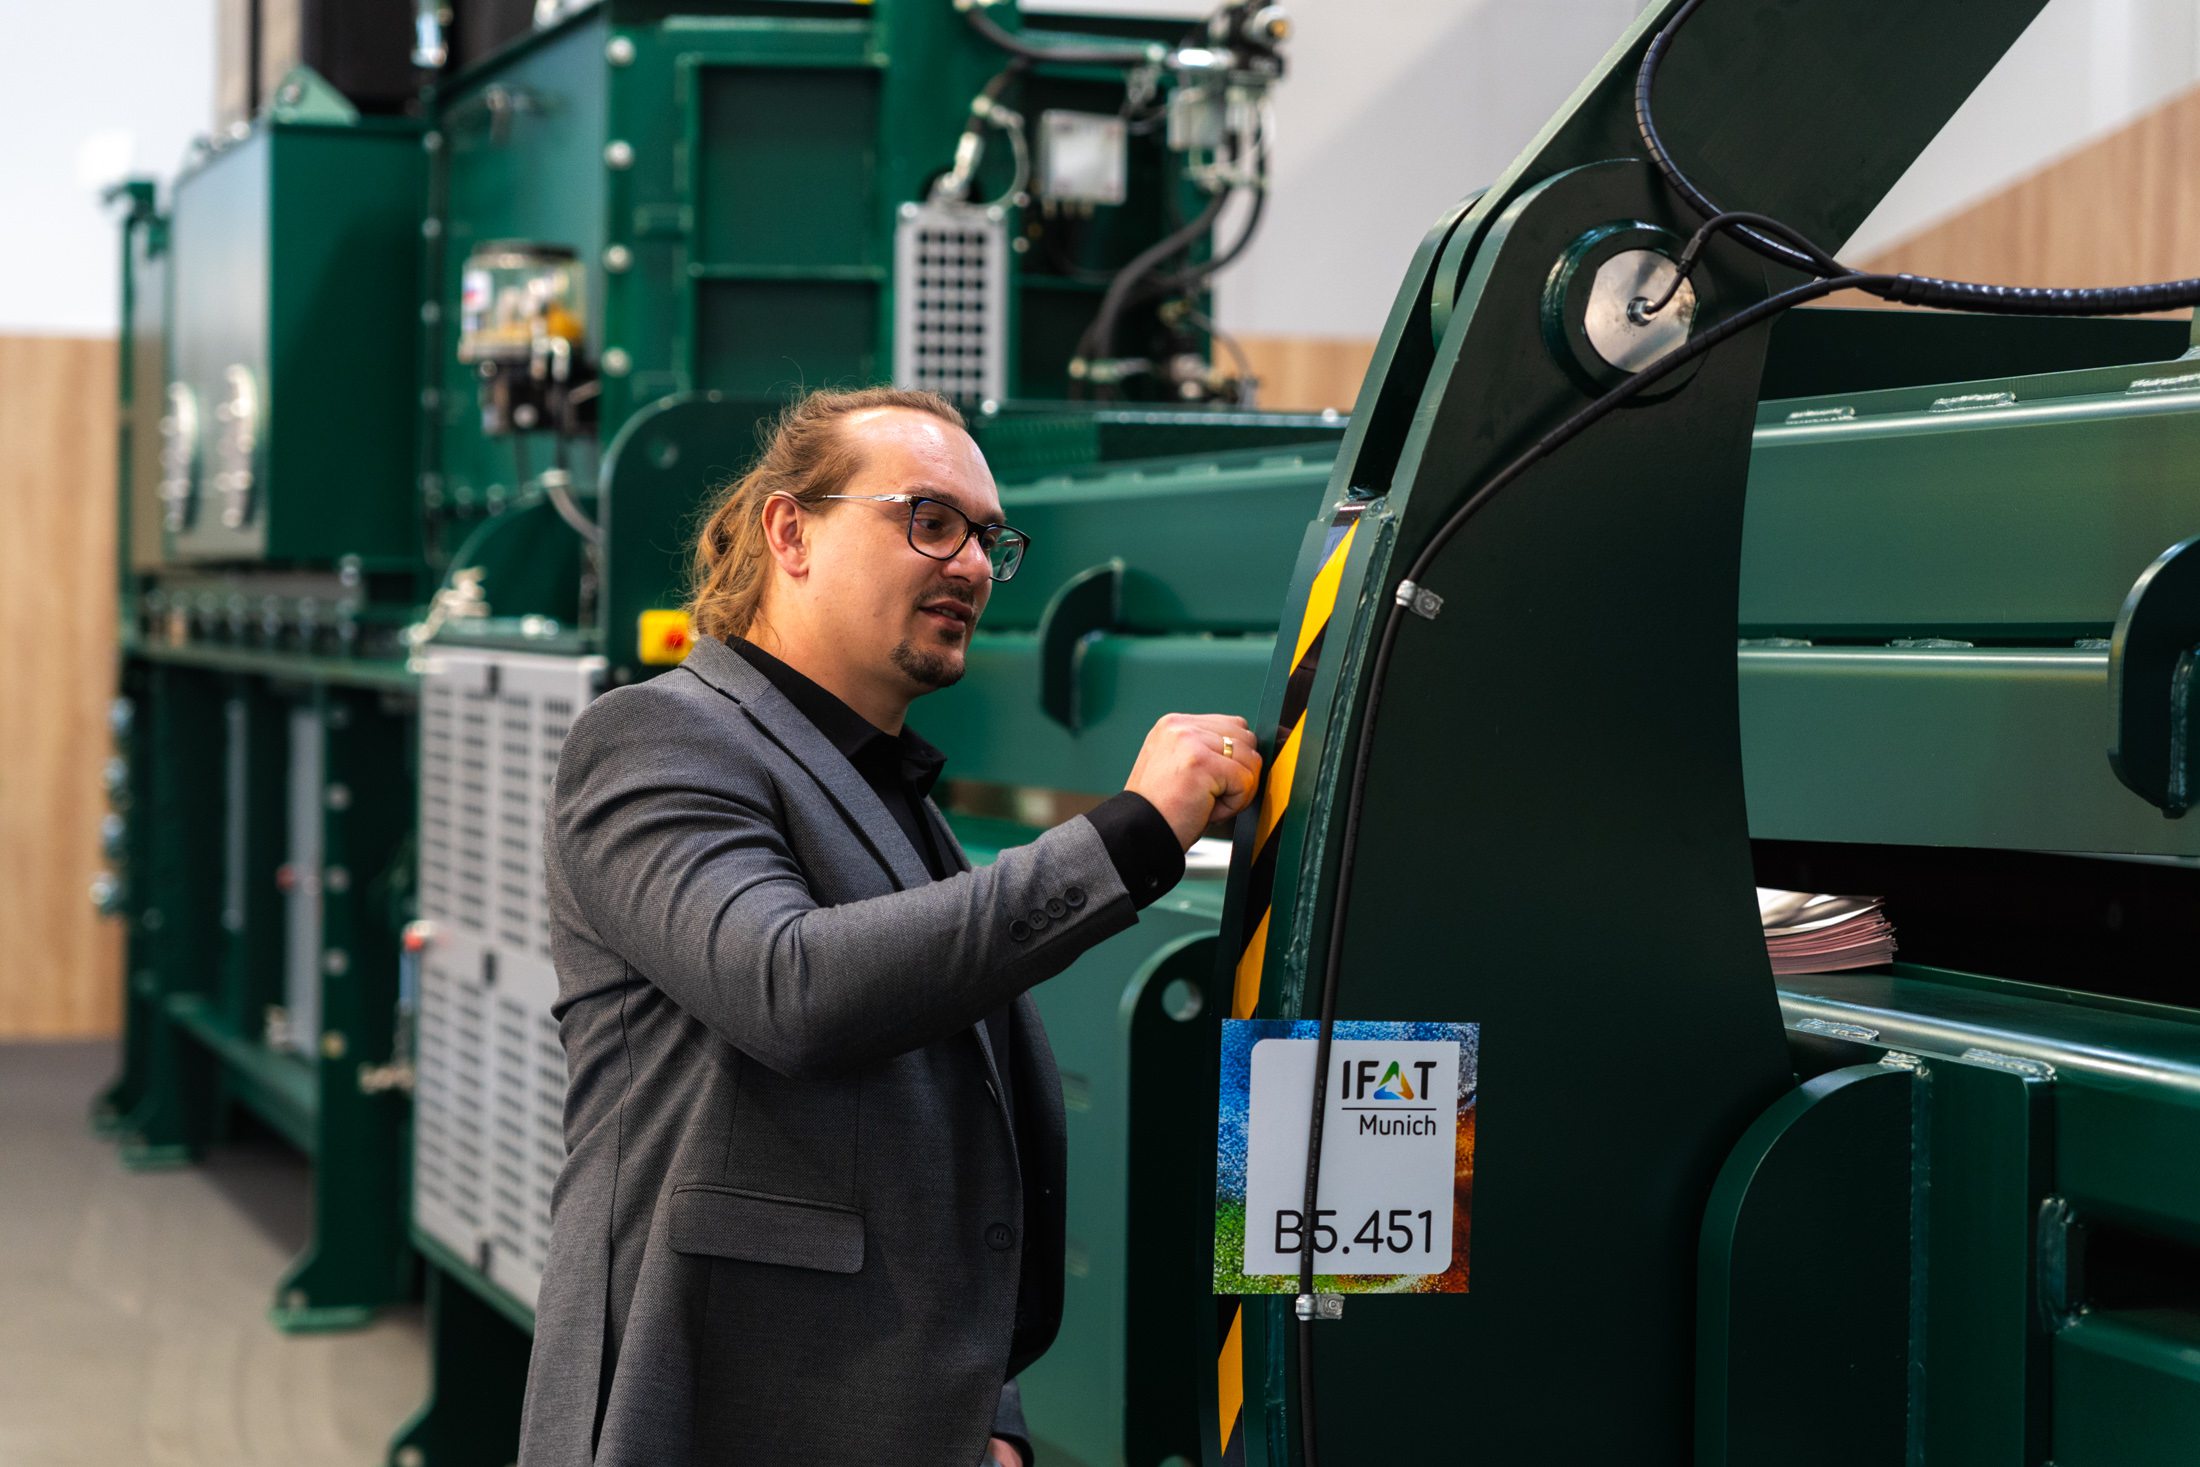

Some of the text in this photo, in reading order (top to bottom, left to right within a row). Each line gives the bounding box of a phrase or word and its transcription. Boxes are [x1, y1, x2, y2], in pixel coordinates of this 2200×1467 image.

[1342, 1060, 1437, 1100] IFAT
[1359, 1114, 1436, 1136] Munich
[1275, 1210, 1432, 1254] B5.451
